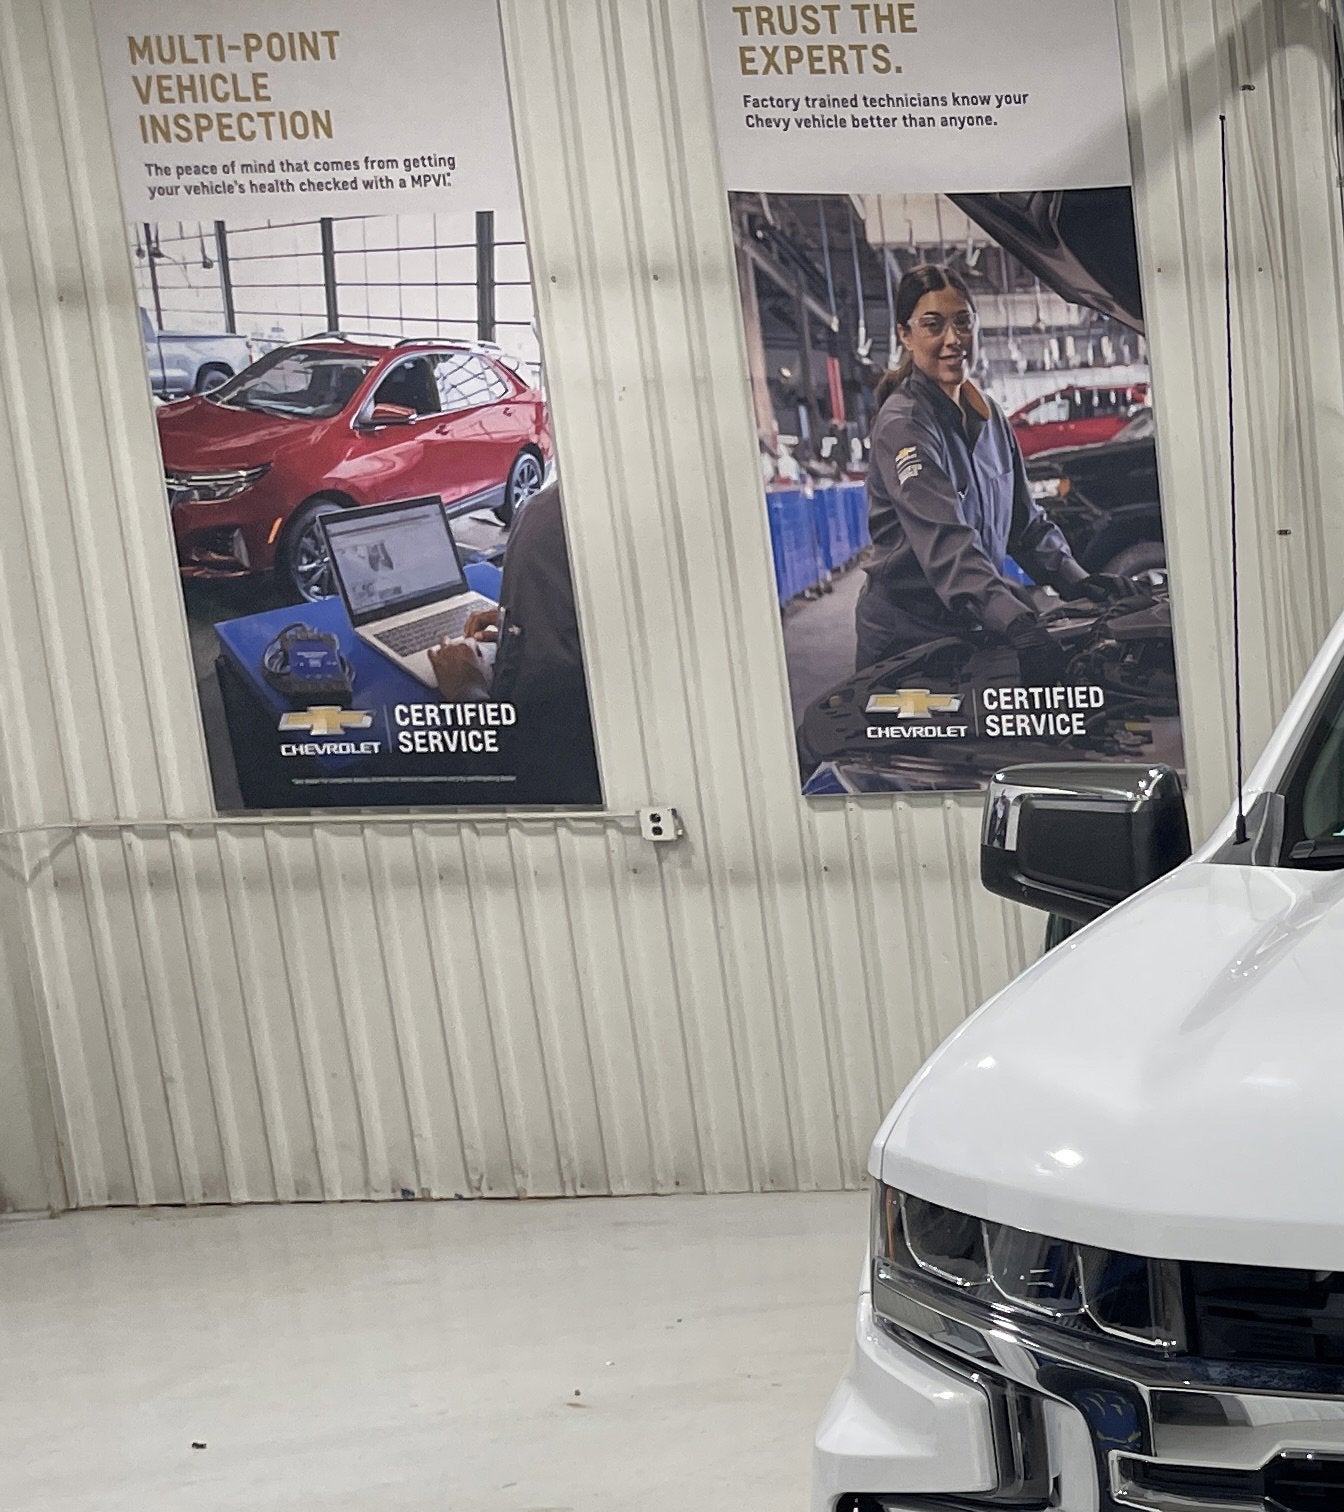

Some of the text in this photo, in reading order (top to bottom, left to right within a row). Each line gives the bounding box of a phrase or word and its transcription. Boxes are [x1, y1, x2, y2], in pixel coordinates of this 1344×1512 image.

[732, 3, 917, 36] TRUST THE
[128, 30, 340, 66] MULTI-POINT
[739, 43, 903, 76] EXPERTS.
[132, 72, 272, 105] VEHICLE
[743, 92, 1029, 111] Factory trained technicians know your
[139, 109, 334, 144] INSPECTION
[745, 113, 998, 131] Chevy vehicle better than anyone.
[145, 153, 456, 180] The peace of mind that comes from getting
[147, 185, 180, 200] your
[184, 180, 246, 195] vehicle's
[250, 179, 295, 194] health
[299, 177, 358, 192] checked
[362, 176, 394, 190] with
[399, 178, 407, 188] a
[983, 686, 1105, 710] CERTIFIED
[394, 703, 517, 726] CERTIFIED
[985, 713, 1087, 737] SERVICE
[398, 730, 499, 753] SERVICE
[866, 725, 968, 739] CHEVROLET
[280, 741, 382, 756] CHEVROLET
